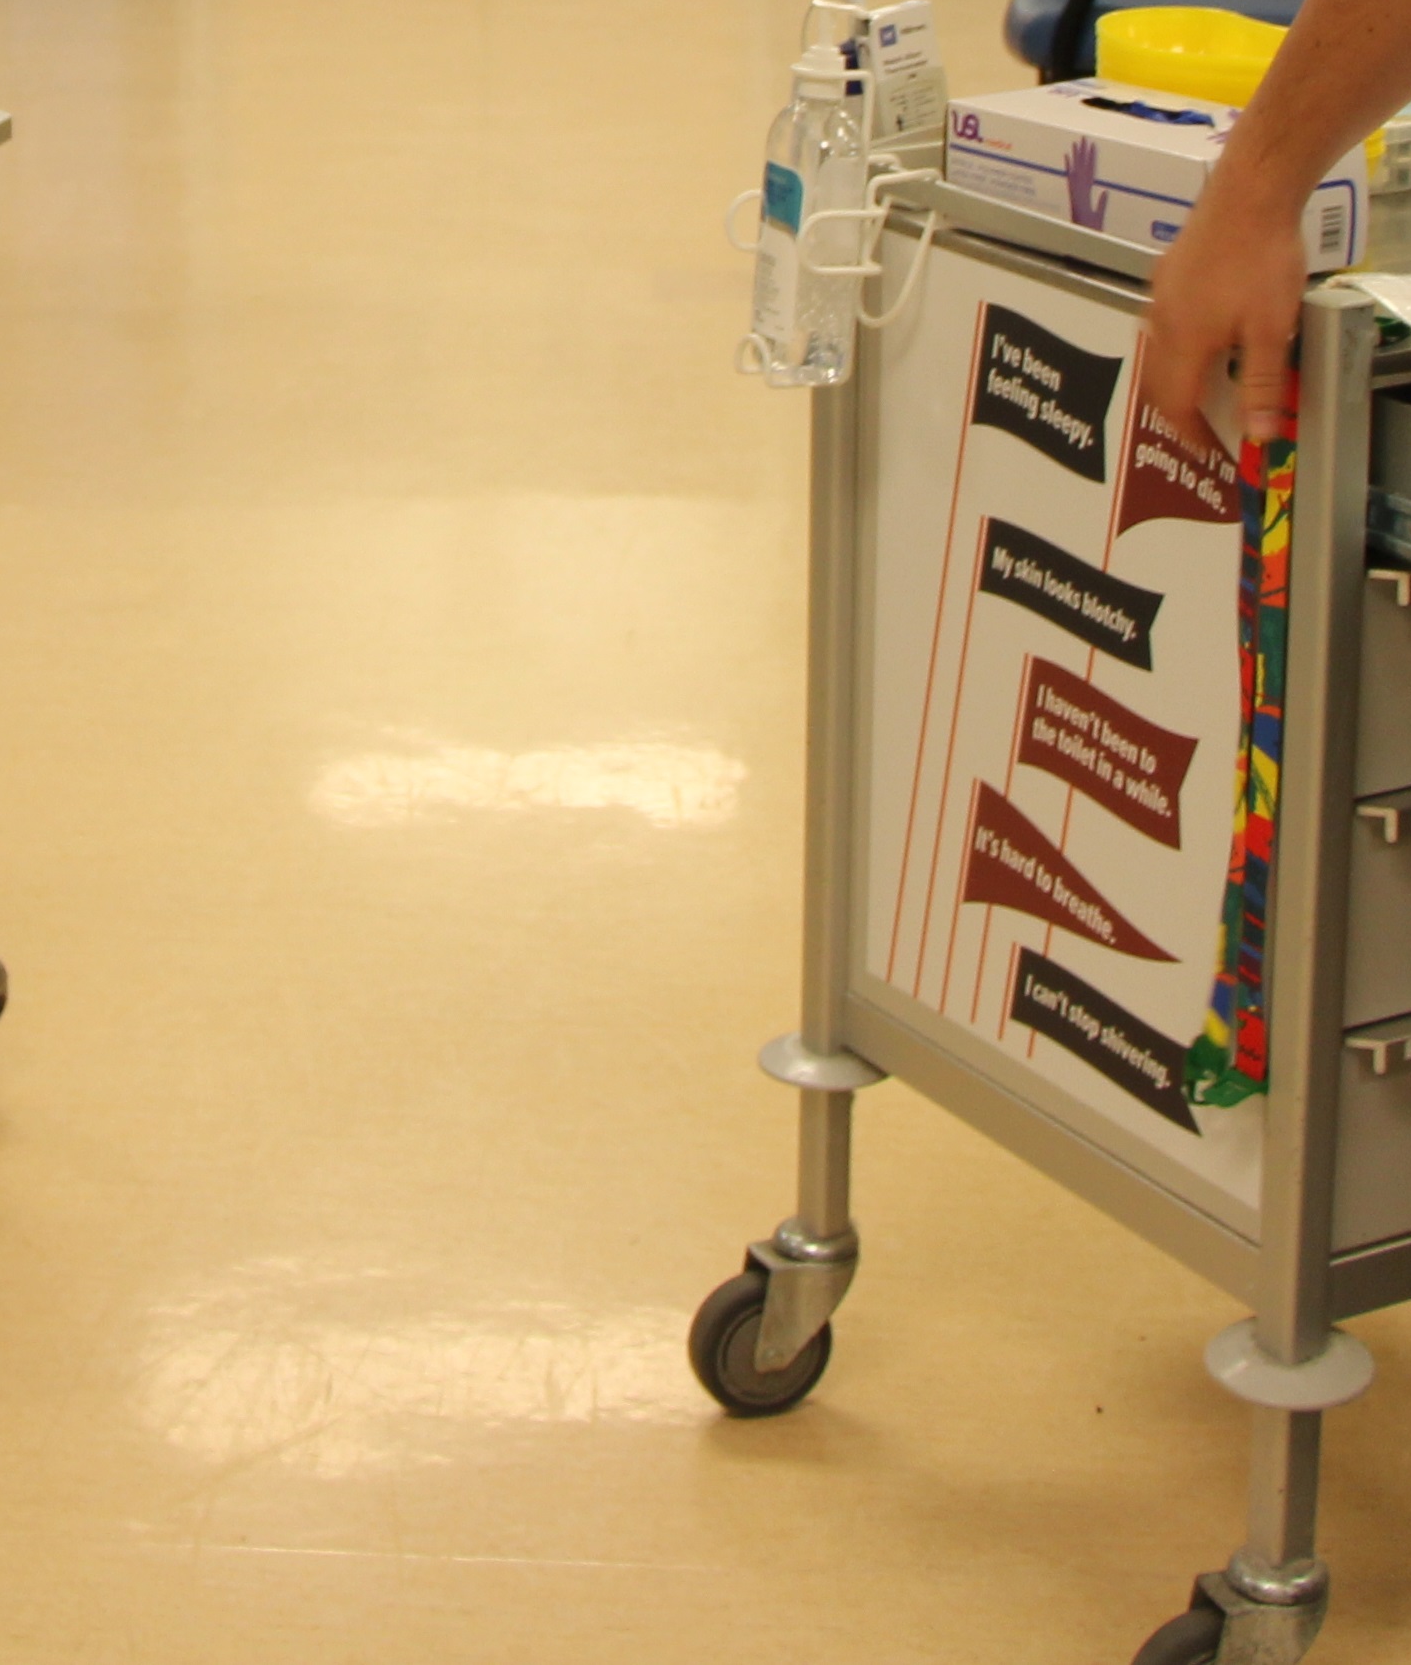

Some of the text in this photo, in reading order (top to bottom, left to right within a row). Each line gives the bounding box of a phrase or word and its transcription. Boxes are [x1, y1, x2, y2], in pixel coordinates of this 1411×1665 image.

[991, 333, 1061, 392] I've been
[987, 368, 1094, 450] feeling sleepy.
[1140, 404, 1150, 429] I
[1208, 448, 1236, 484] I'm
[1135, 442, 1178, 482] going
[1180, 464, 1196, 490] to
[1197, 476, 1227, 514] die.
[991, 546, 1138, 642] My skin looks blotchy.
[1032, 716, 1173, 818] the toilet in a while.
[1036, 685, 1157, 775] I haven't been to
[974, 826, 1117, 945] It's hard to breathe.
[1024, 973, 1171, 1089] I can't stop shivering.
